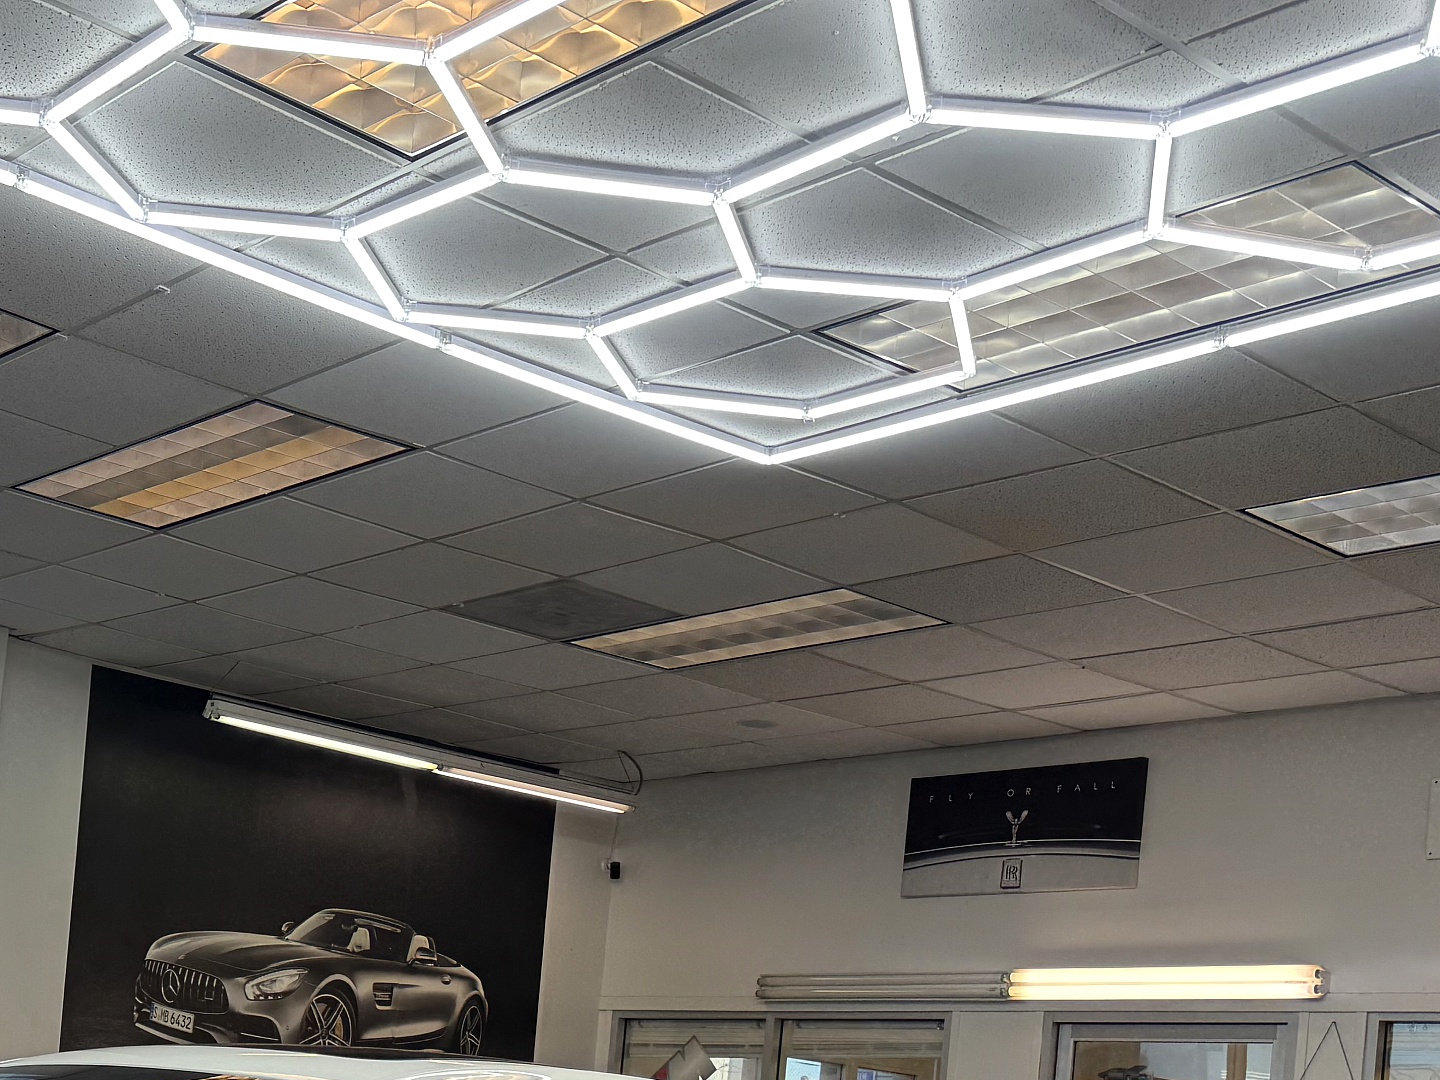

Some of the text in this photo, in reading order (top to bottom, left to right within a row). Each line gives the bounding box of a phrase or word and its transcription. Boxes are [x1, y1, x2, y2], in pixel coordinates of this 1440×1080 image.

[929, 780, 1116, 804] FLY OR FALL
[170, 1012, 192, 1030] 6432
